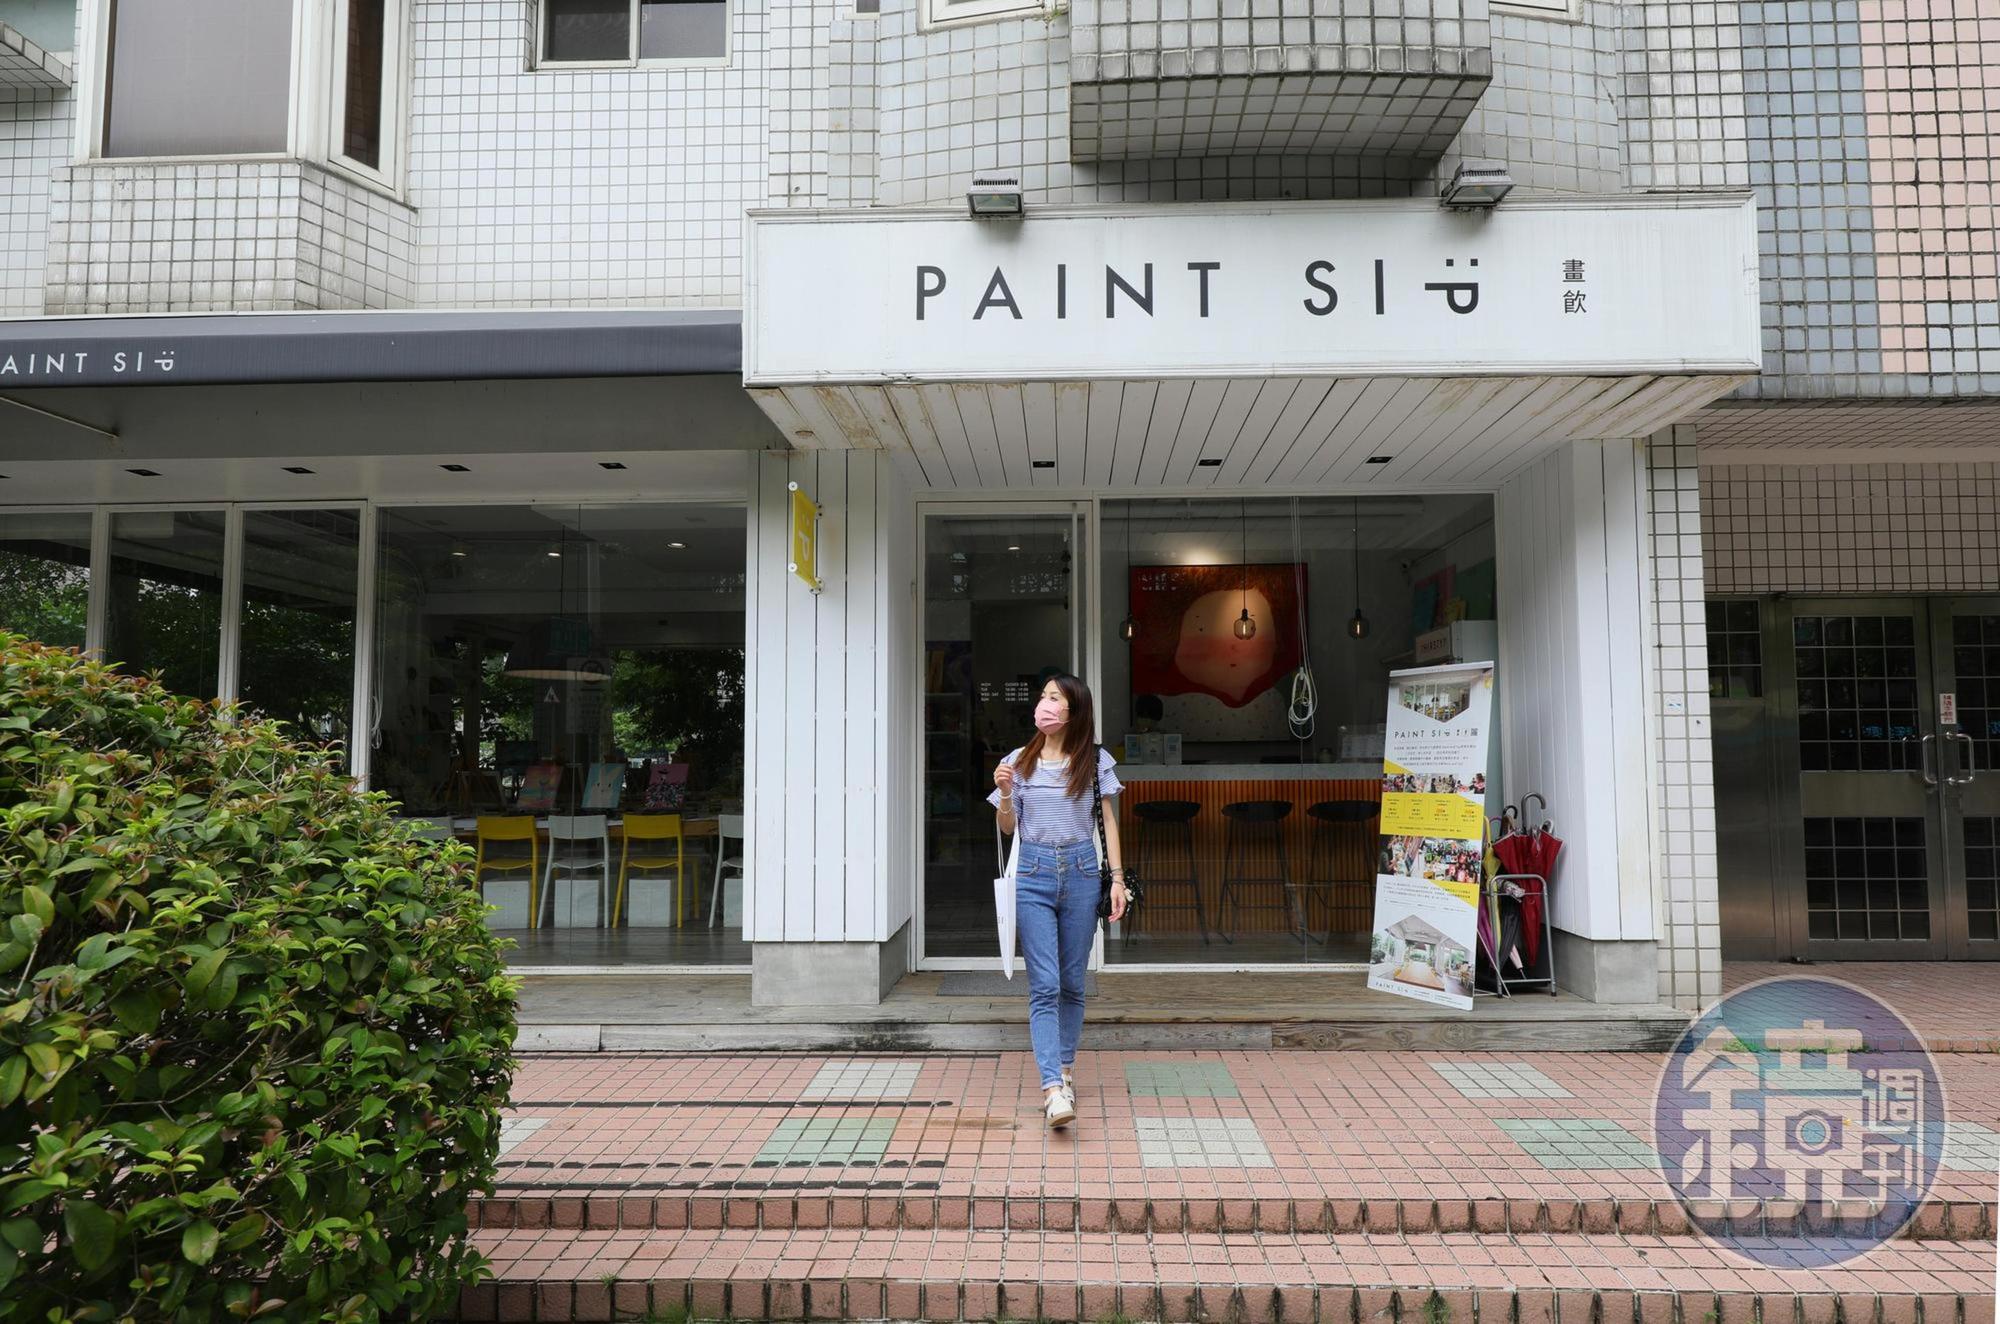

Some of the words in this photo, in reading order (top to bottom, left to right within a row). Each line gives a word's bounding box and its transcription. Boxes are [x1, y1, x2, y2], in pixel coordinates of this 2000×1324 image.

[917, 262, 1220, 320] PAINT
[1562, 258, 1588, 314] 畫飲
[1394, 729, 1425, 739] PAINT
